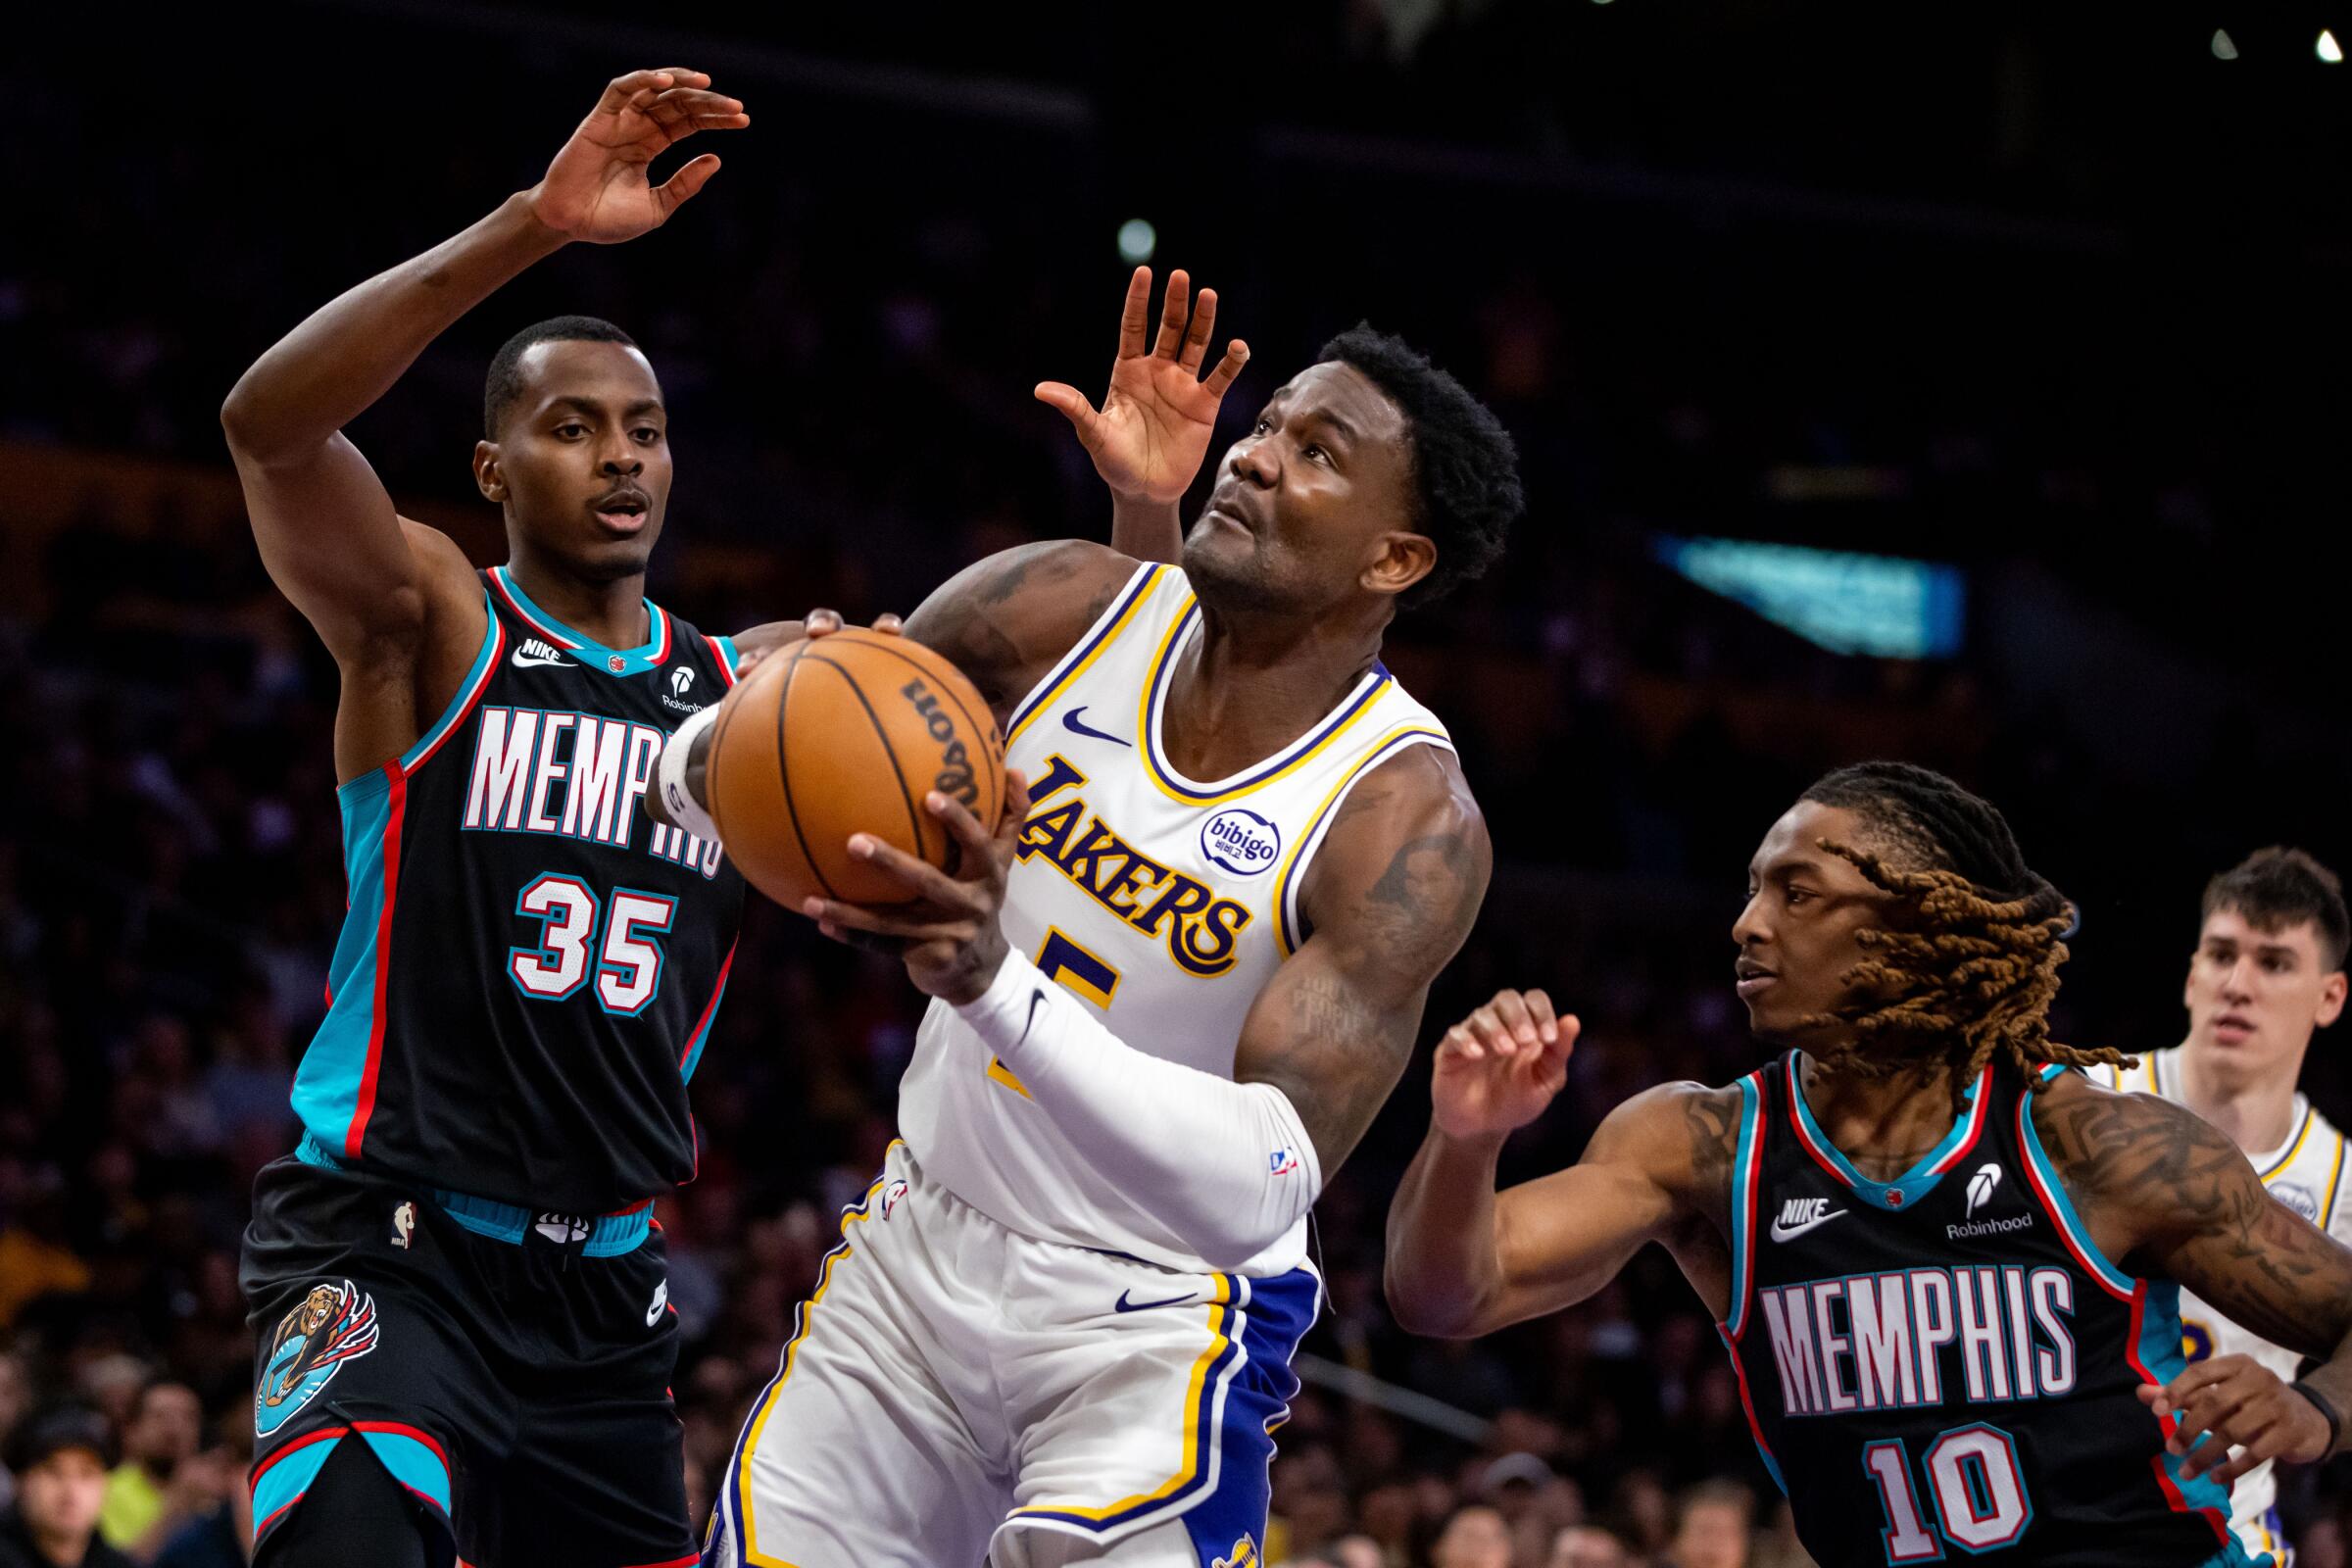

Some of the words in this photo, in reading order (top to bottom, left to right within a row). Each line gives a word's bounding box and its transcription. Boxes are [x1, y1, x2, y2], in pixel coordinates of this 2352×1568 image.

[520, 638, 561, 662] NIKE
[662, 694, 707, 713] Robinh
[1210, 817, 1274, 860] bibigo
[1214, 840, 1243, 859] 비비고
[1015, 753, 1254, 979] LAKERS
[507, 870, 679, 1017] 35
[1779, 1198, 1830, 1224] NIKE
[1945, 1212, 2034, 1241] Robinhood
[1758, 1264, 2077, 1418] MEMPHIS
[1863, 1421, 2034, 1567] 10
